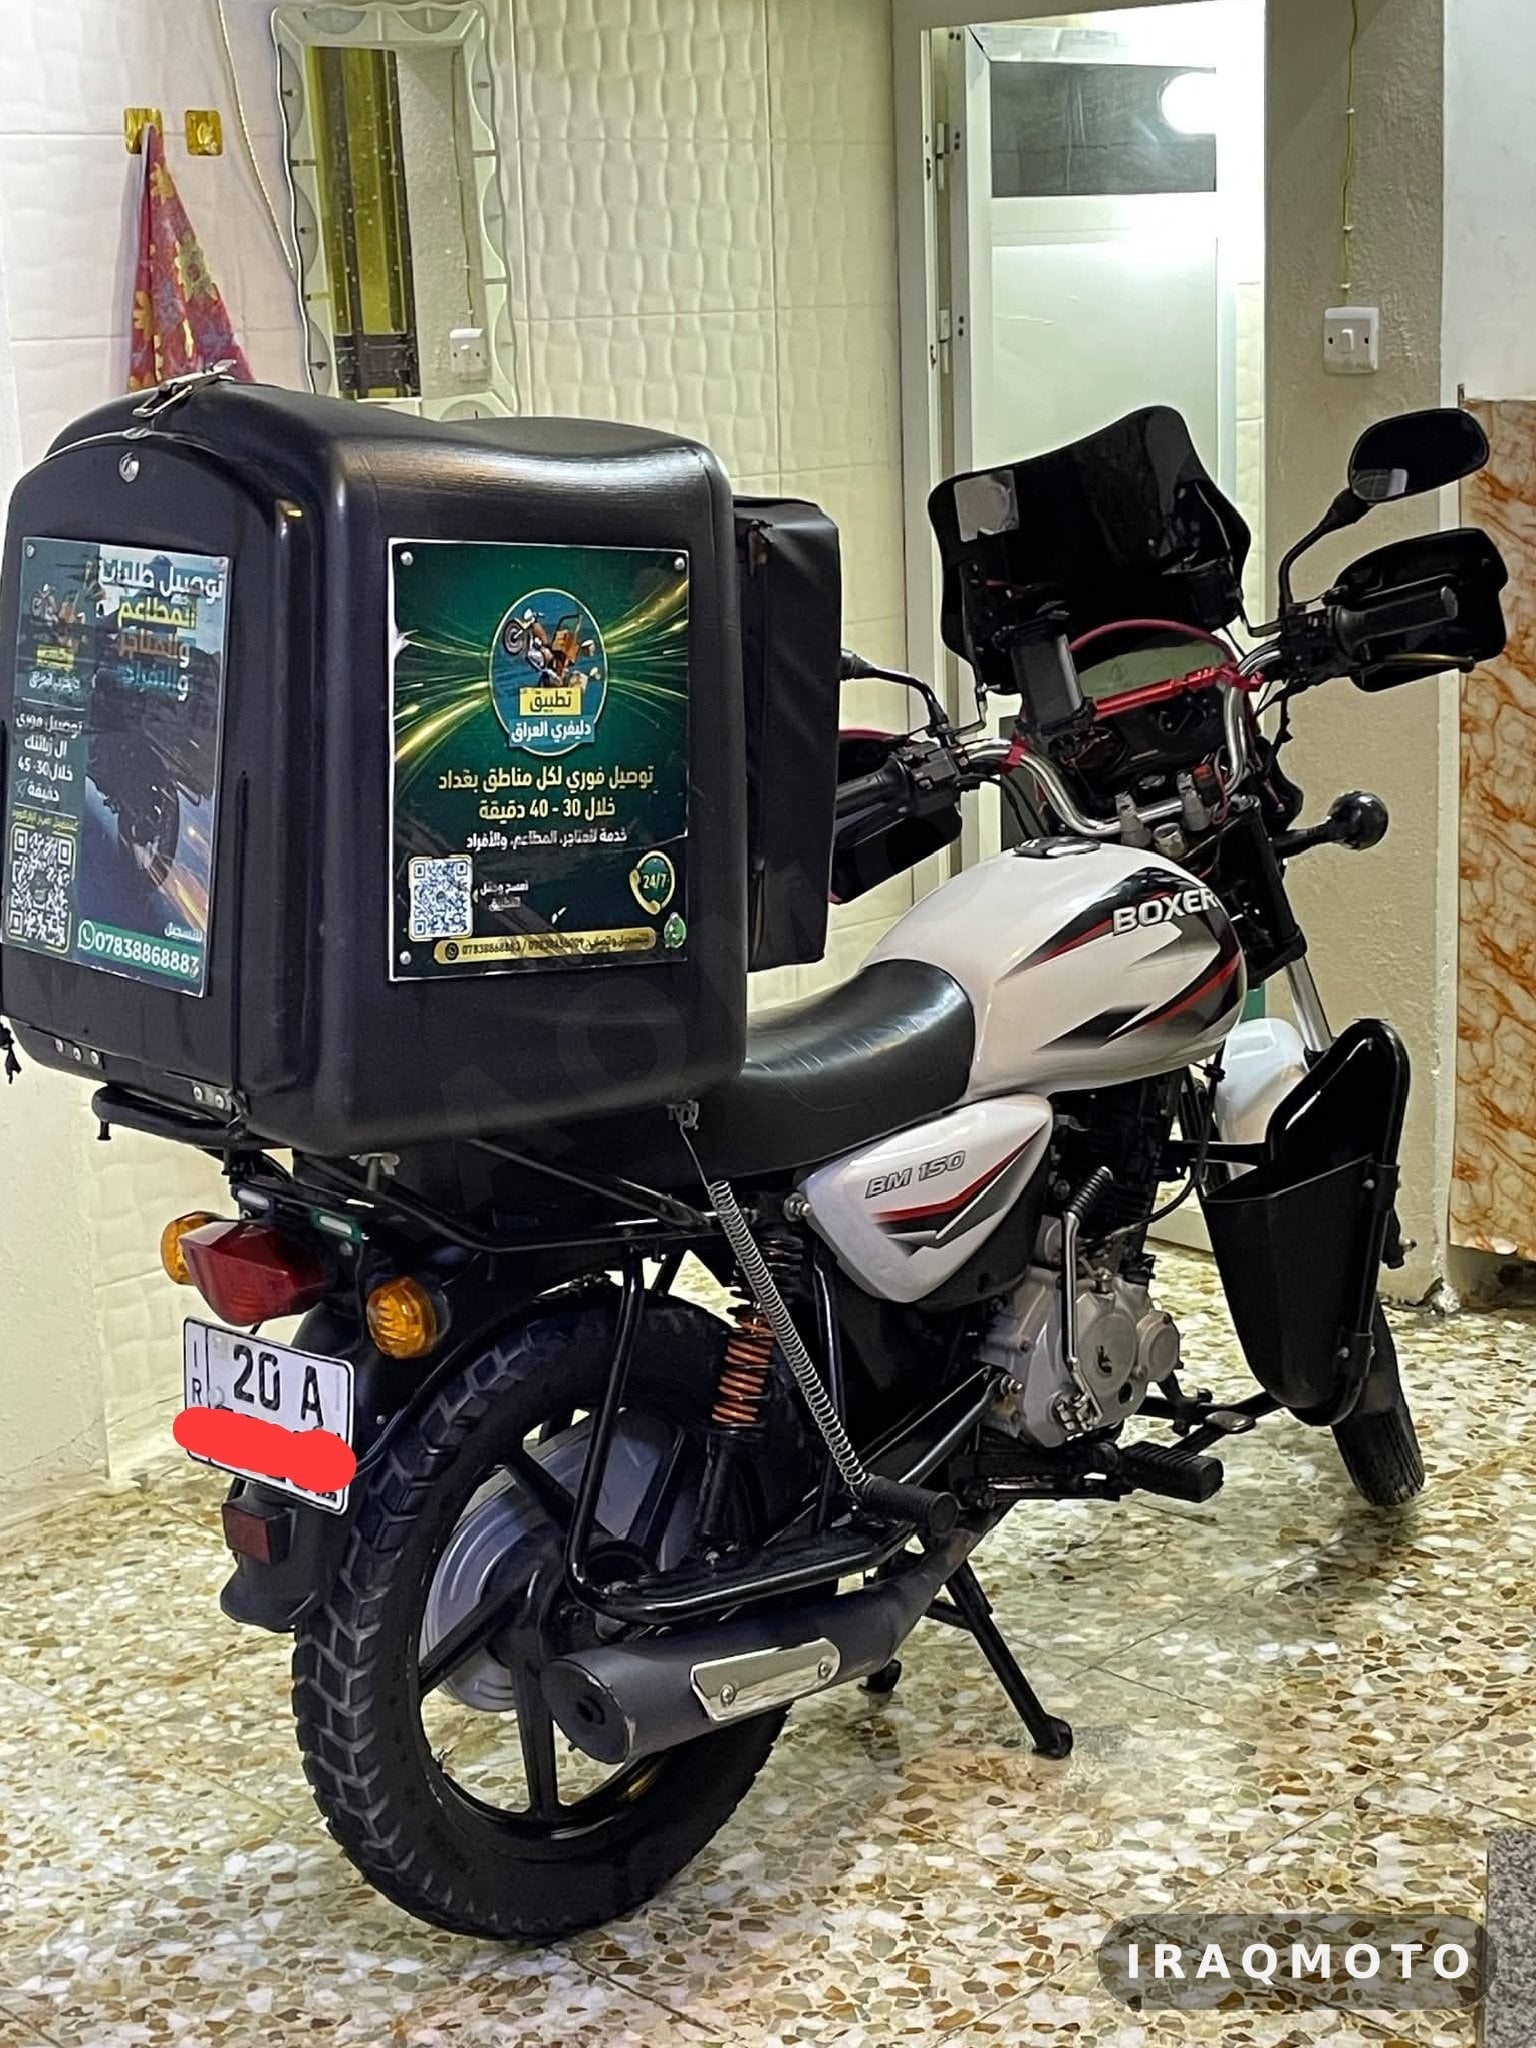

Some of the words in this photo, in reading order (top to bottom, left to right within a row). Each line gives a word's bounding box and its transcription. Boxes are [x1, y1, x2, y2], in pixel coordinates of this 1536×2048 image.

[159, 566, 226, 605] توصيل
[118, 596, 196, 628] المطاعم
[530, 689, 572, 713] تطبيق
[45, 714, 83, 739] توصيل
[511, 721, 549, 743] العراق
[550, 721, 592, 744] دليفري
[49, 762, 74, 782] خلال
[438, 769, 479, 794] بغداد
[483, 767, 533, 793] مناطق
[536, 765, 563, 791] لكل
[566, 765, 605, 795] فوري
[609, 764, 655, 790] توصيل
[27, 780, 60, 803] دقيقة
[479, 799, 526, 825] دقيقة
[529, 798, 549, 818] 40
[562, 798, 582, 817] 30
[584, 797, 617, 821] خلال
[599, 826, 628, 844] خدمة
[642, 872, 668, 889] 24/7
[1112, 887, 1219, 936] BOXER
[865, 1167, 912, 1199] BM
[918, 1151, 966, 1181] 150
[233, 1344, 281, 1412] 20
[300, 1365, 325, 1427] A
